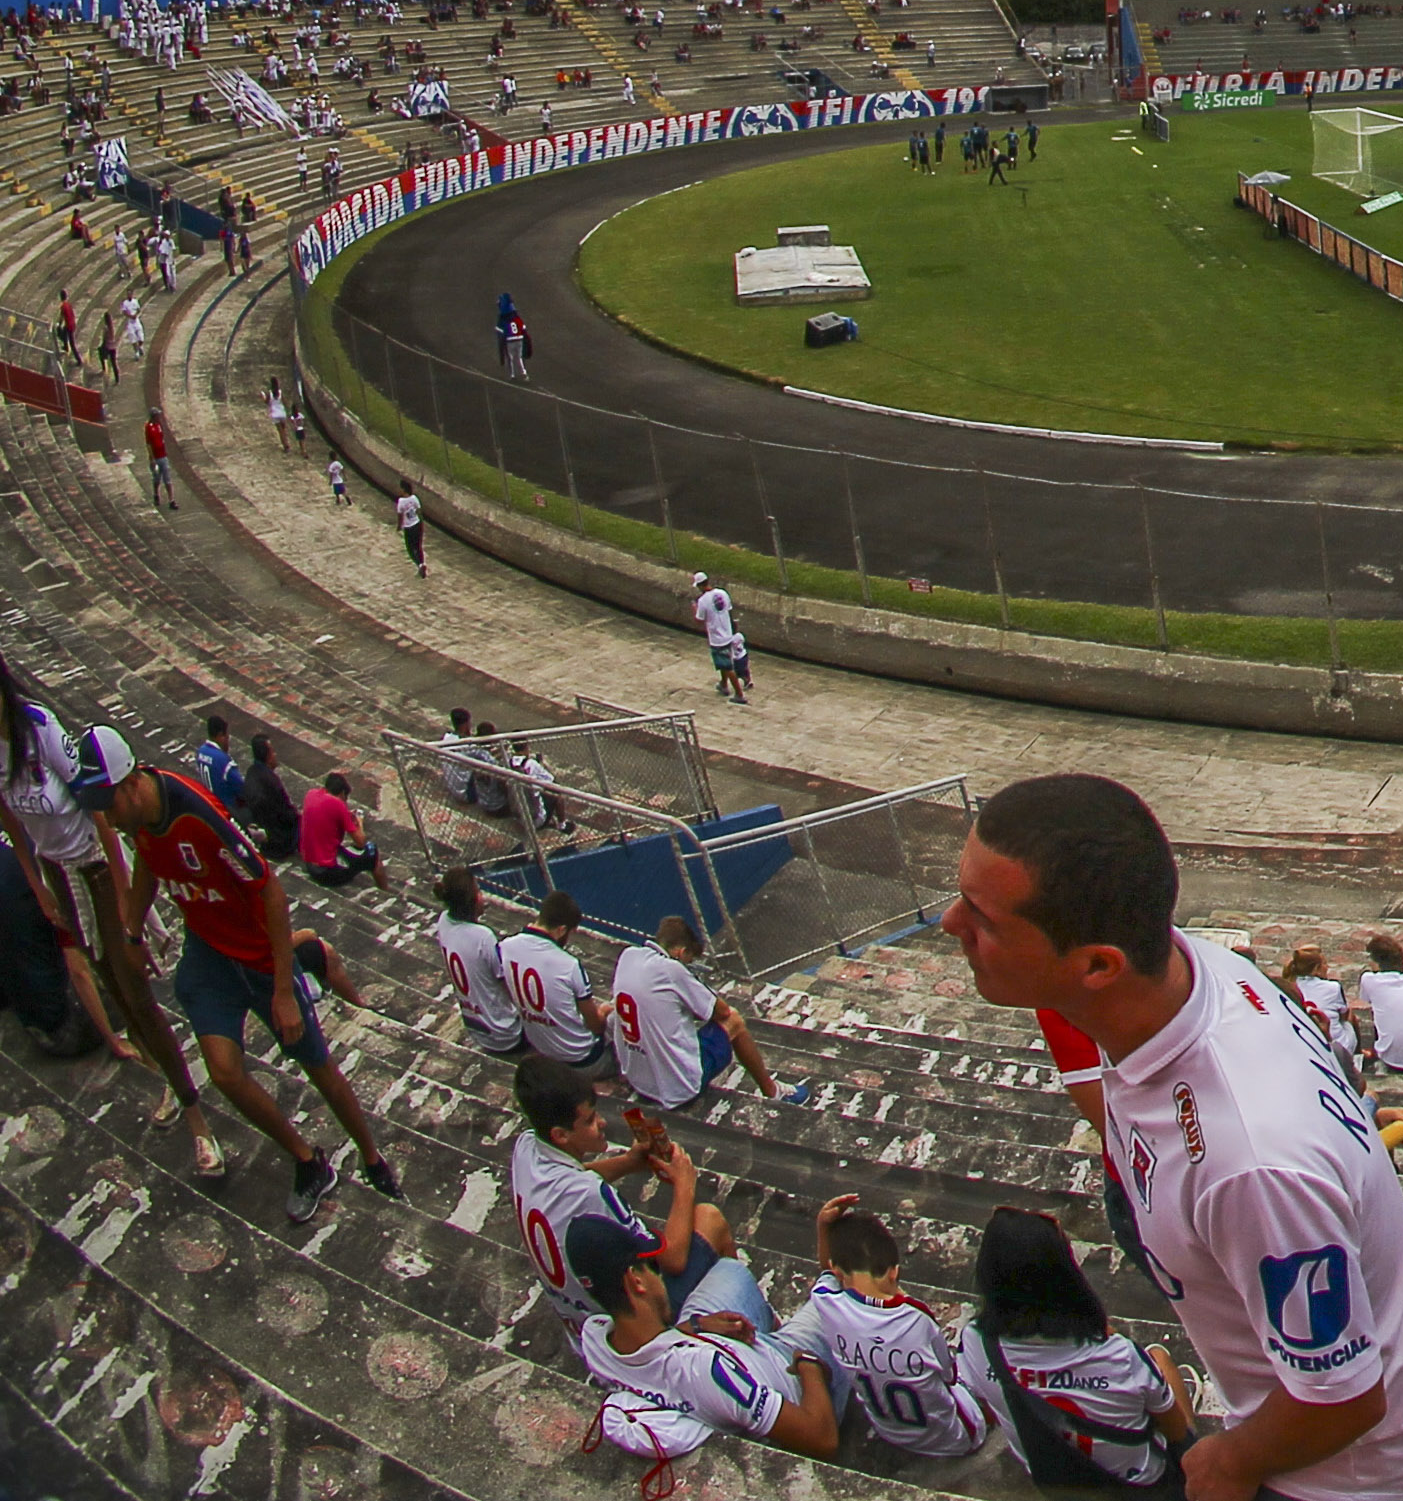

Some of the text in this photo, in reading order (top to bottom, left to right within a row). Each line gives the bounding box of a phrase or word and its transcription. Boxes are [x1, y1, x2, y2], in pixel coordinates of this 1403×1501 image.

[1212, 92, 1263, 108] Sicredi
[322, 177, 405, 262] TORCIDA
[502, 110, 722, 183] INDEPENDENTE
[510, 961, 545, 1013] 10
[616, 992, 641, 1043] 9
[836, 1333, 926, 1377] RACCO
[1267, 1333, 1371, 1373] POTENCIAL
[856, 1373, 928, 1428] 10
